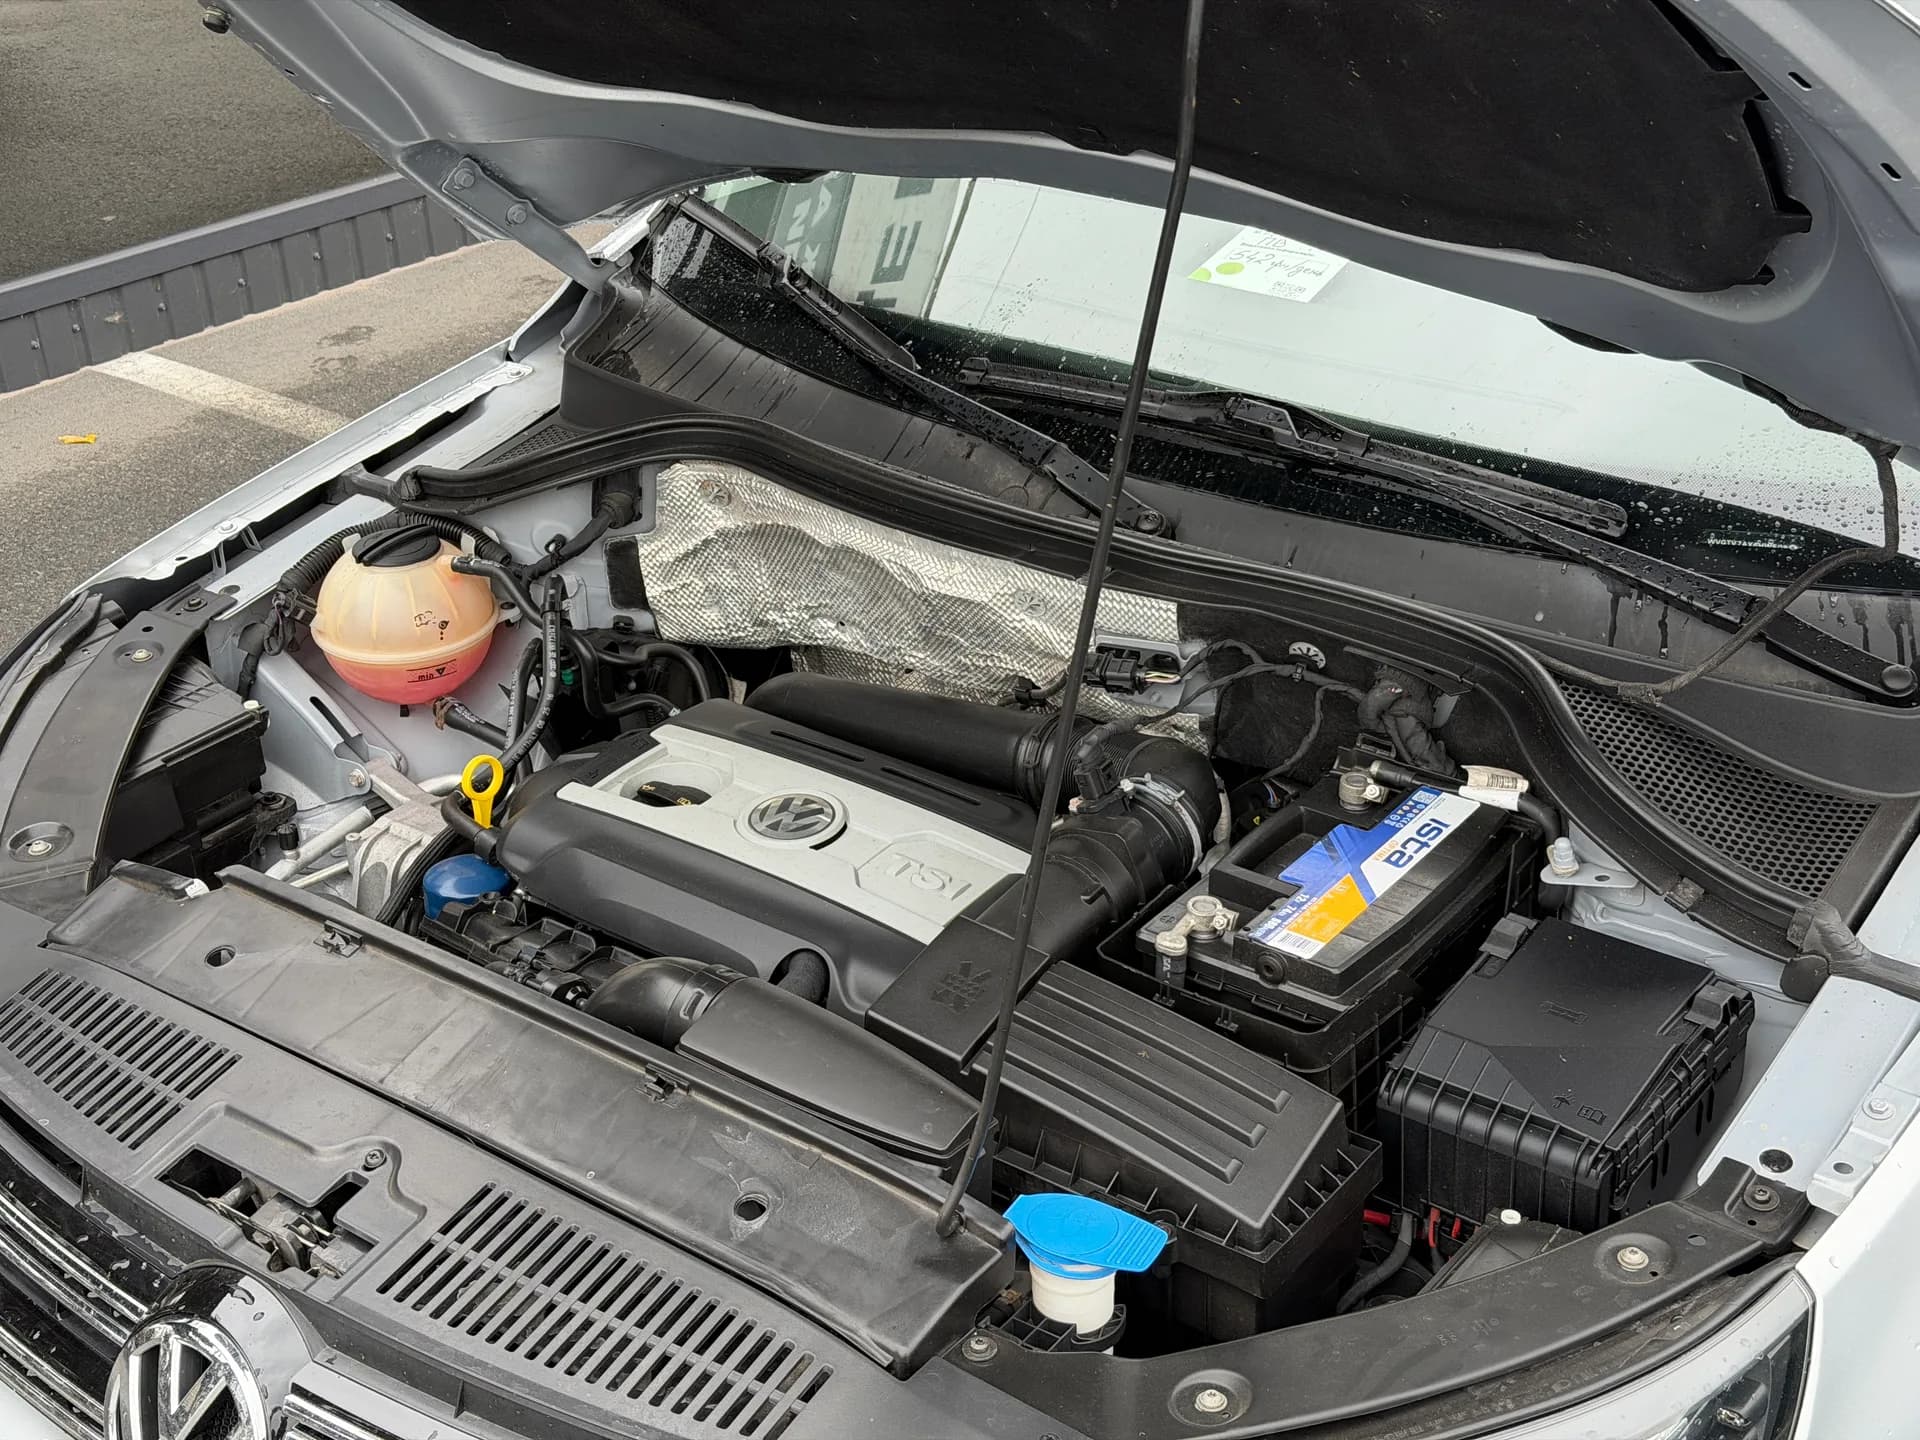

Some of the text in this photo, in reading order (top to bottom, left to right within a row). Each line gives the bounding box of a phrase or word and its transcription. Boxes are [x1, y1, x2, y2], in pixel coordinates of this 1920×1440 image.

[1229, 249, 1276, 265] 542
[417, 672, 435, 682] min
[884, 852, 974, 901] TSI
